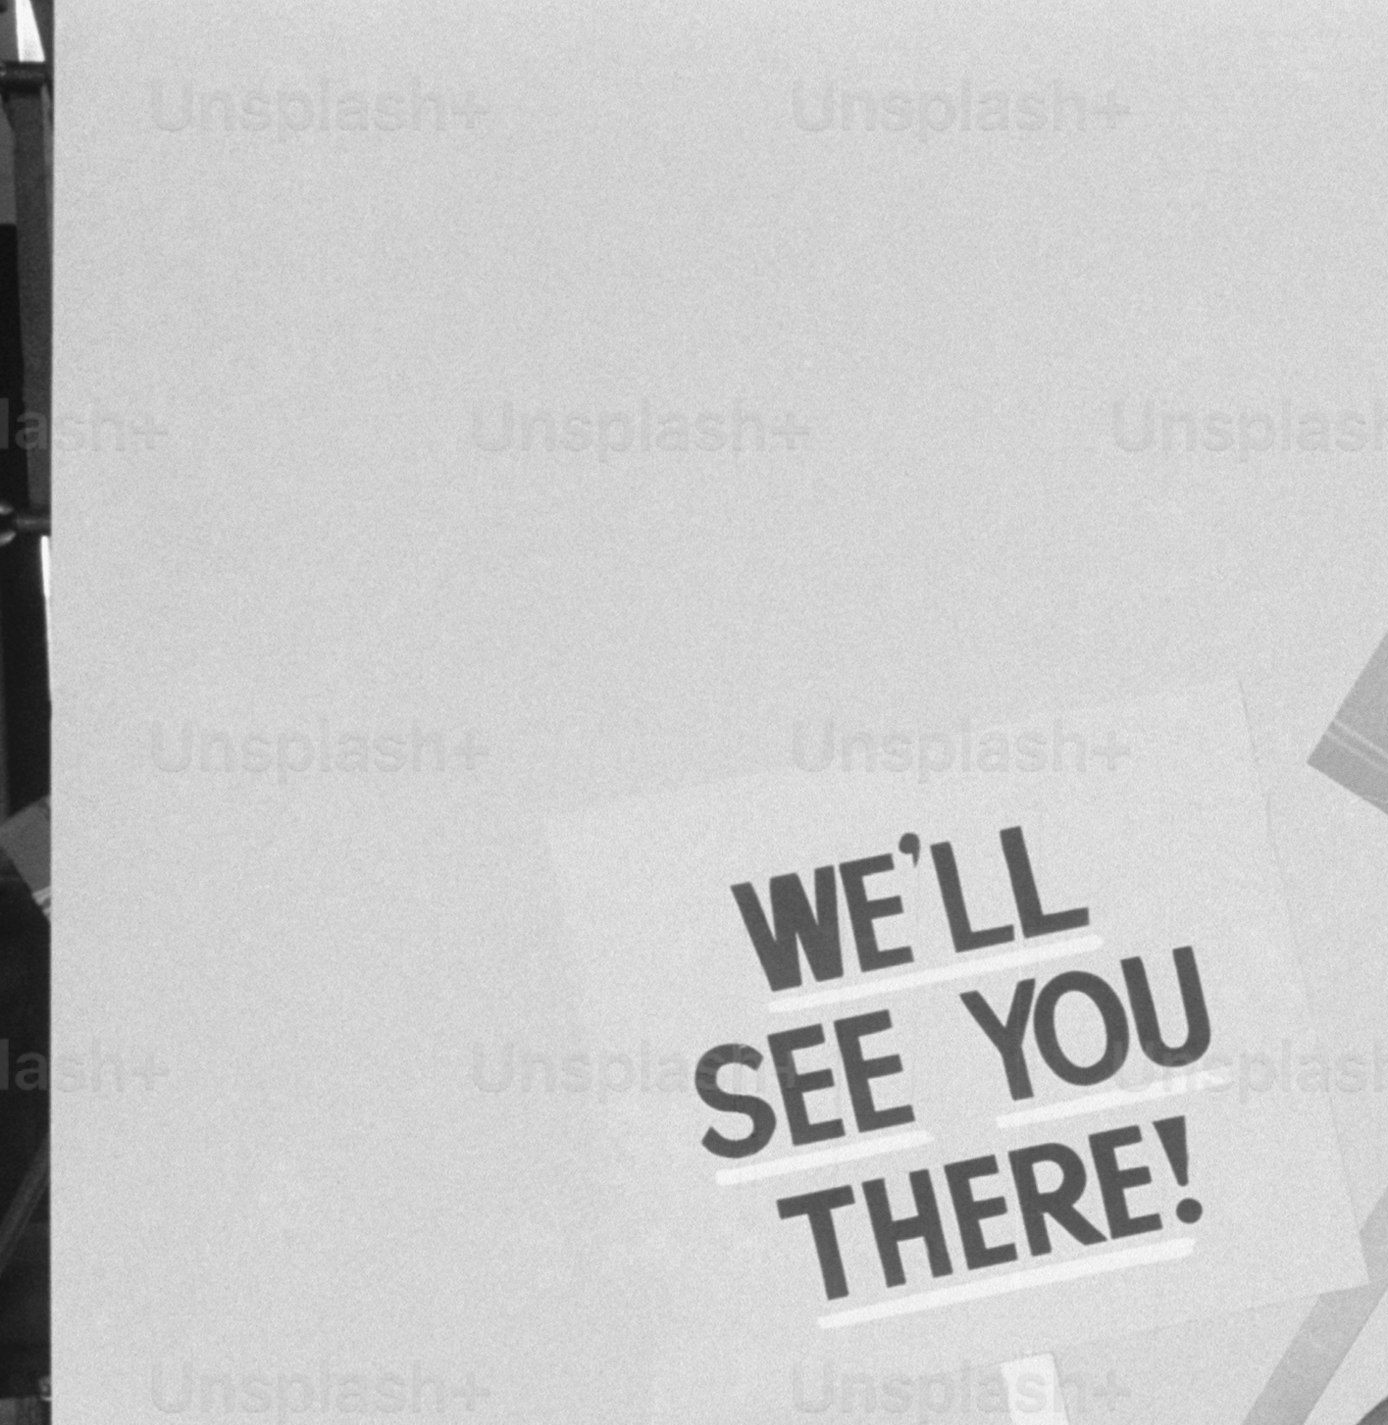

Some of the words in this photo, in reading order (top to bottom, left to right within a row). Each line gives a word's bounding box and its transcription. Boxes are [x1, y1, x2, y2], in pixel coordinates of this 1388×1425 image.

[731, 826, 1089, 991] WE'LL
[694, 1010, 915, 1159] SEE
[961, 946, 1211, 1100] YOU
[777, 1116, 1202, 1300] THERE!
